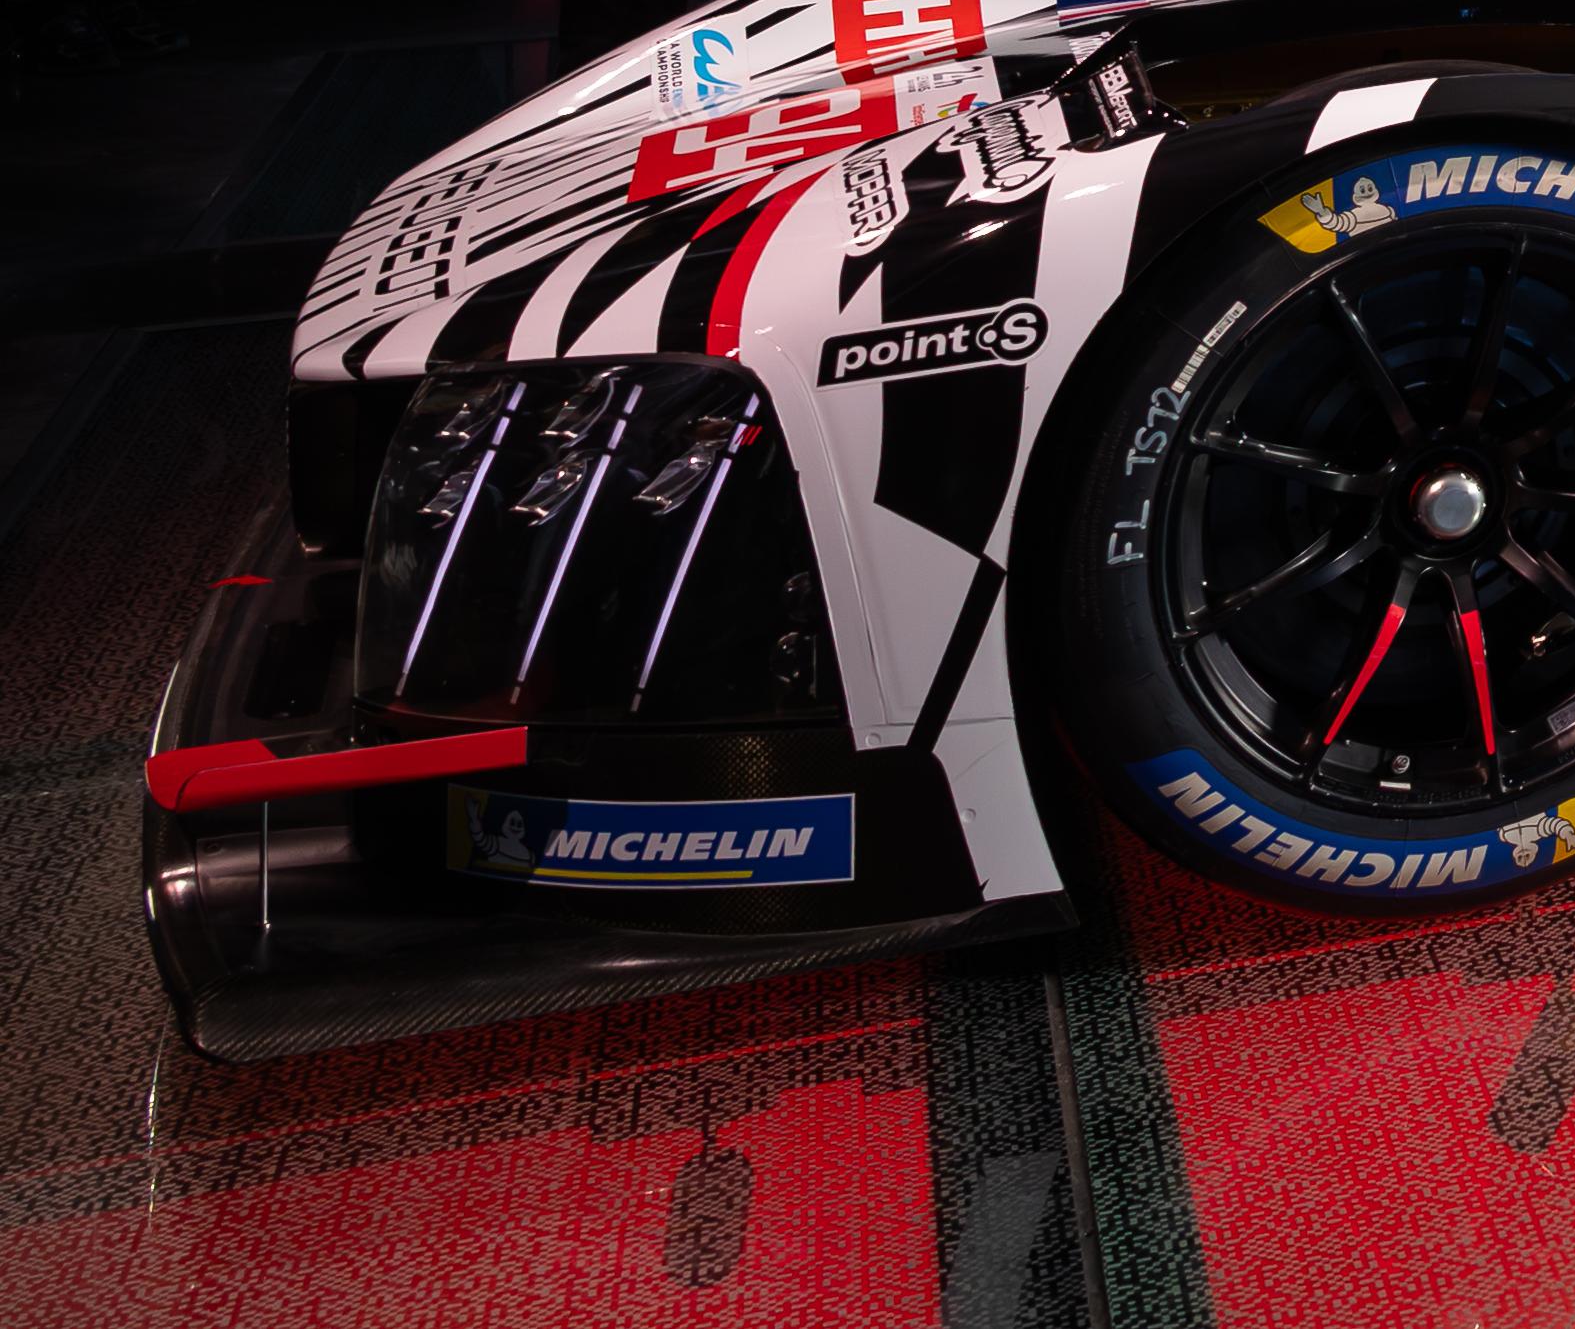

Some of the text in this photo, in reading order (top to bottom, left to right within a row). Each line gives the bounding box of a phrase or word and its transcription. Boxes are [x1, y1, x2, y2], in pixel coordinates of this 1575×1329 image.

[669, 53, 682, 88] WORLD
[666, 89, 862, 188] 94
[843, 151, 897, 244] MOPAR
[836, 327, 971, 376] point
[1107, 501, 1148, 565] FL
[544, 827, 815, 861] MICHELIN
[1158, 771, 1487, 886] MICHELIN
